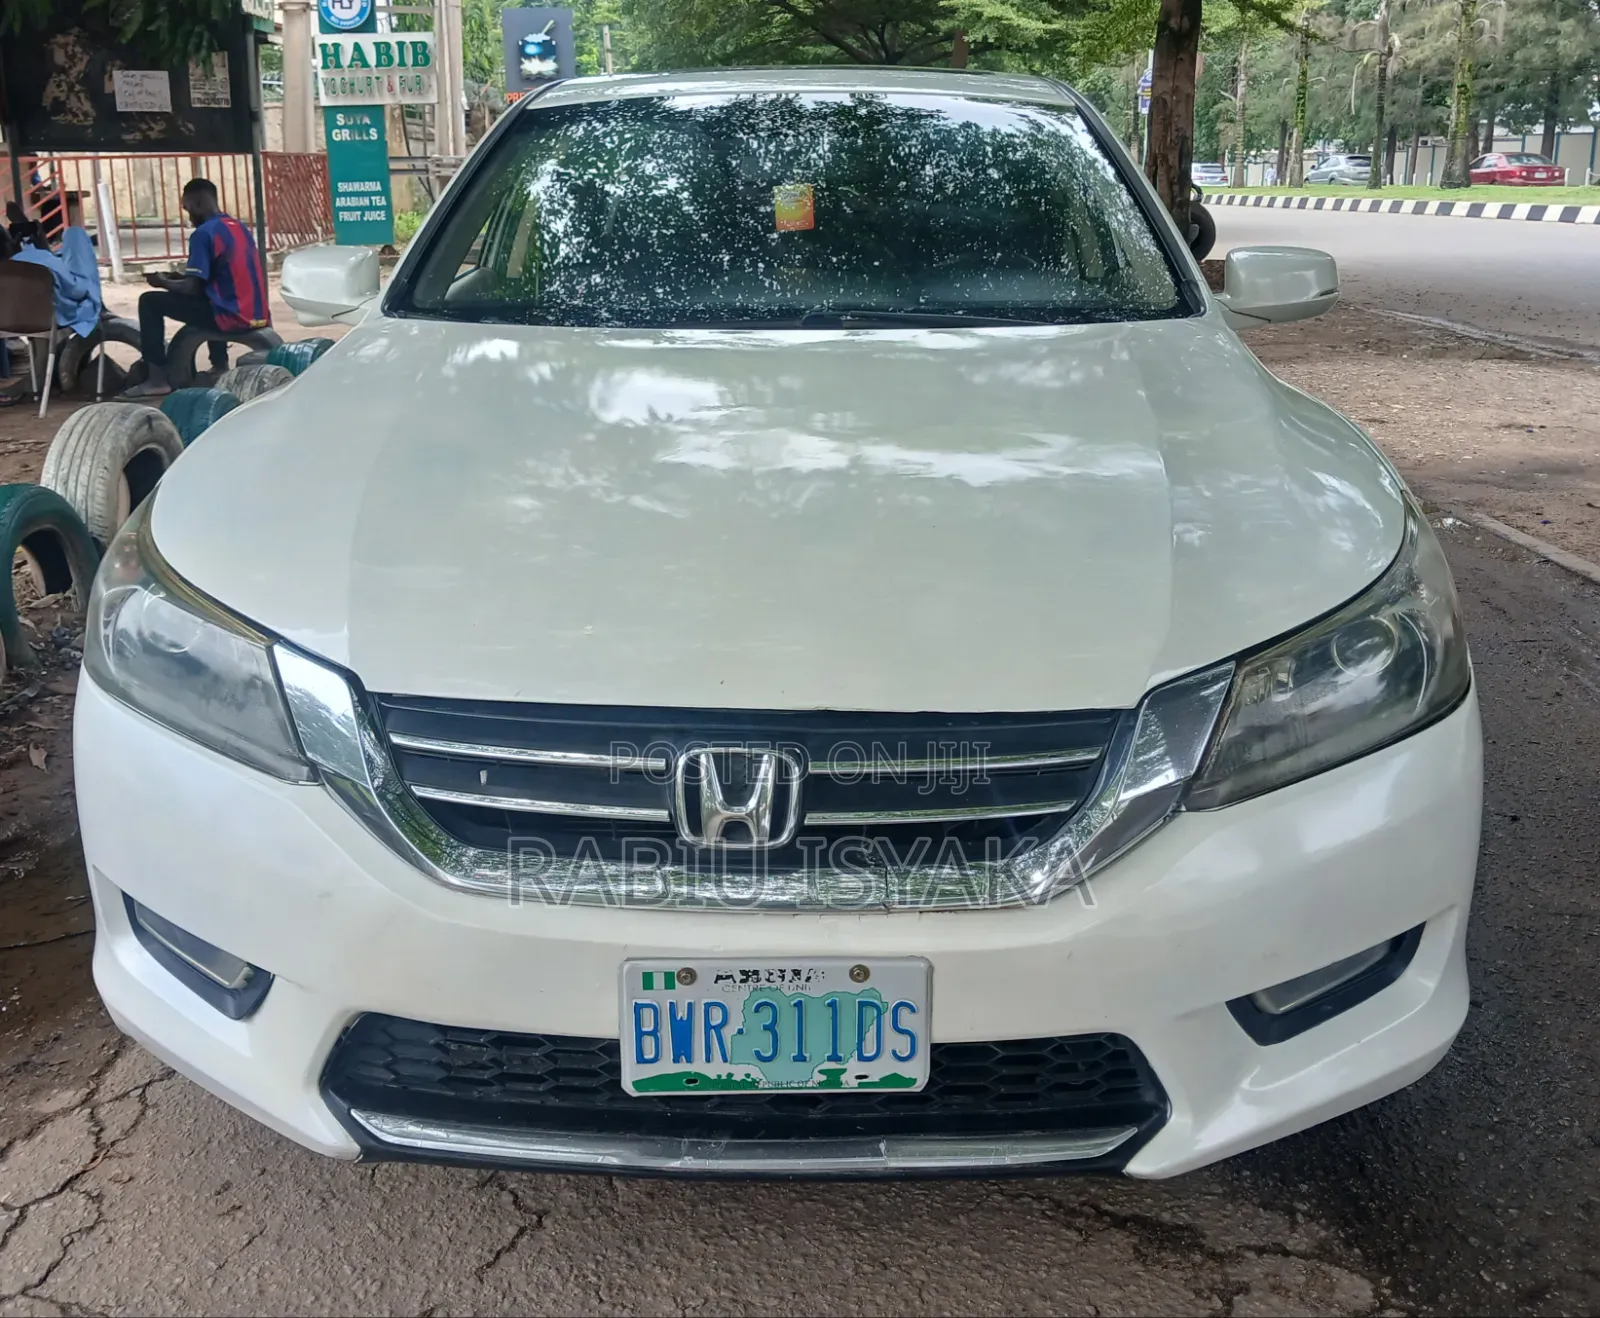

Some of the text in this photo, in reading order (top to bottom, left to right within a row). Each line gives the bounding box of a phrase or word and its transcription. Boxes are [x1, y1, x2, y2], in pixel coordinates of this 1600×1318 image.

[318, 41, 431, 70] HABIB
[321, 75, 382, 96] YOGHURT
[386, 74, 394, 94] &
[332, 127, 378, 142] GRILLS
[337, 181, 382, 193] SHAWARMA
[335, 195, 387, 207] ARABIAN TEA
[339, 210, 387, 222] FRUIT JUICE
